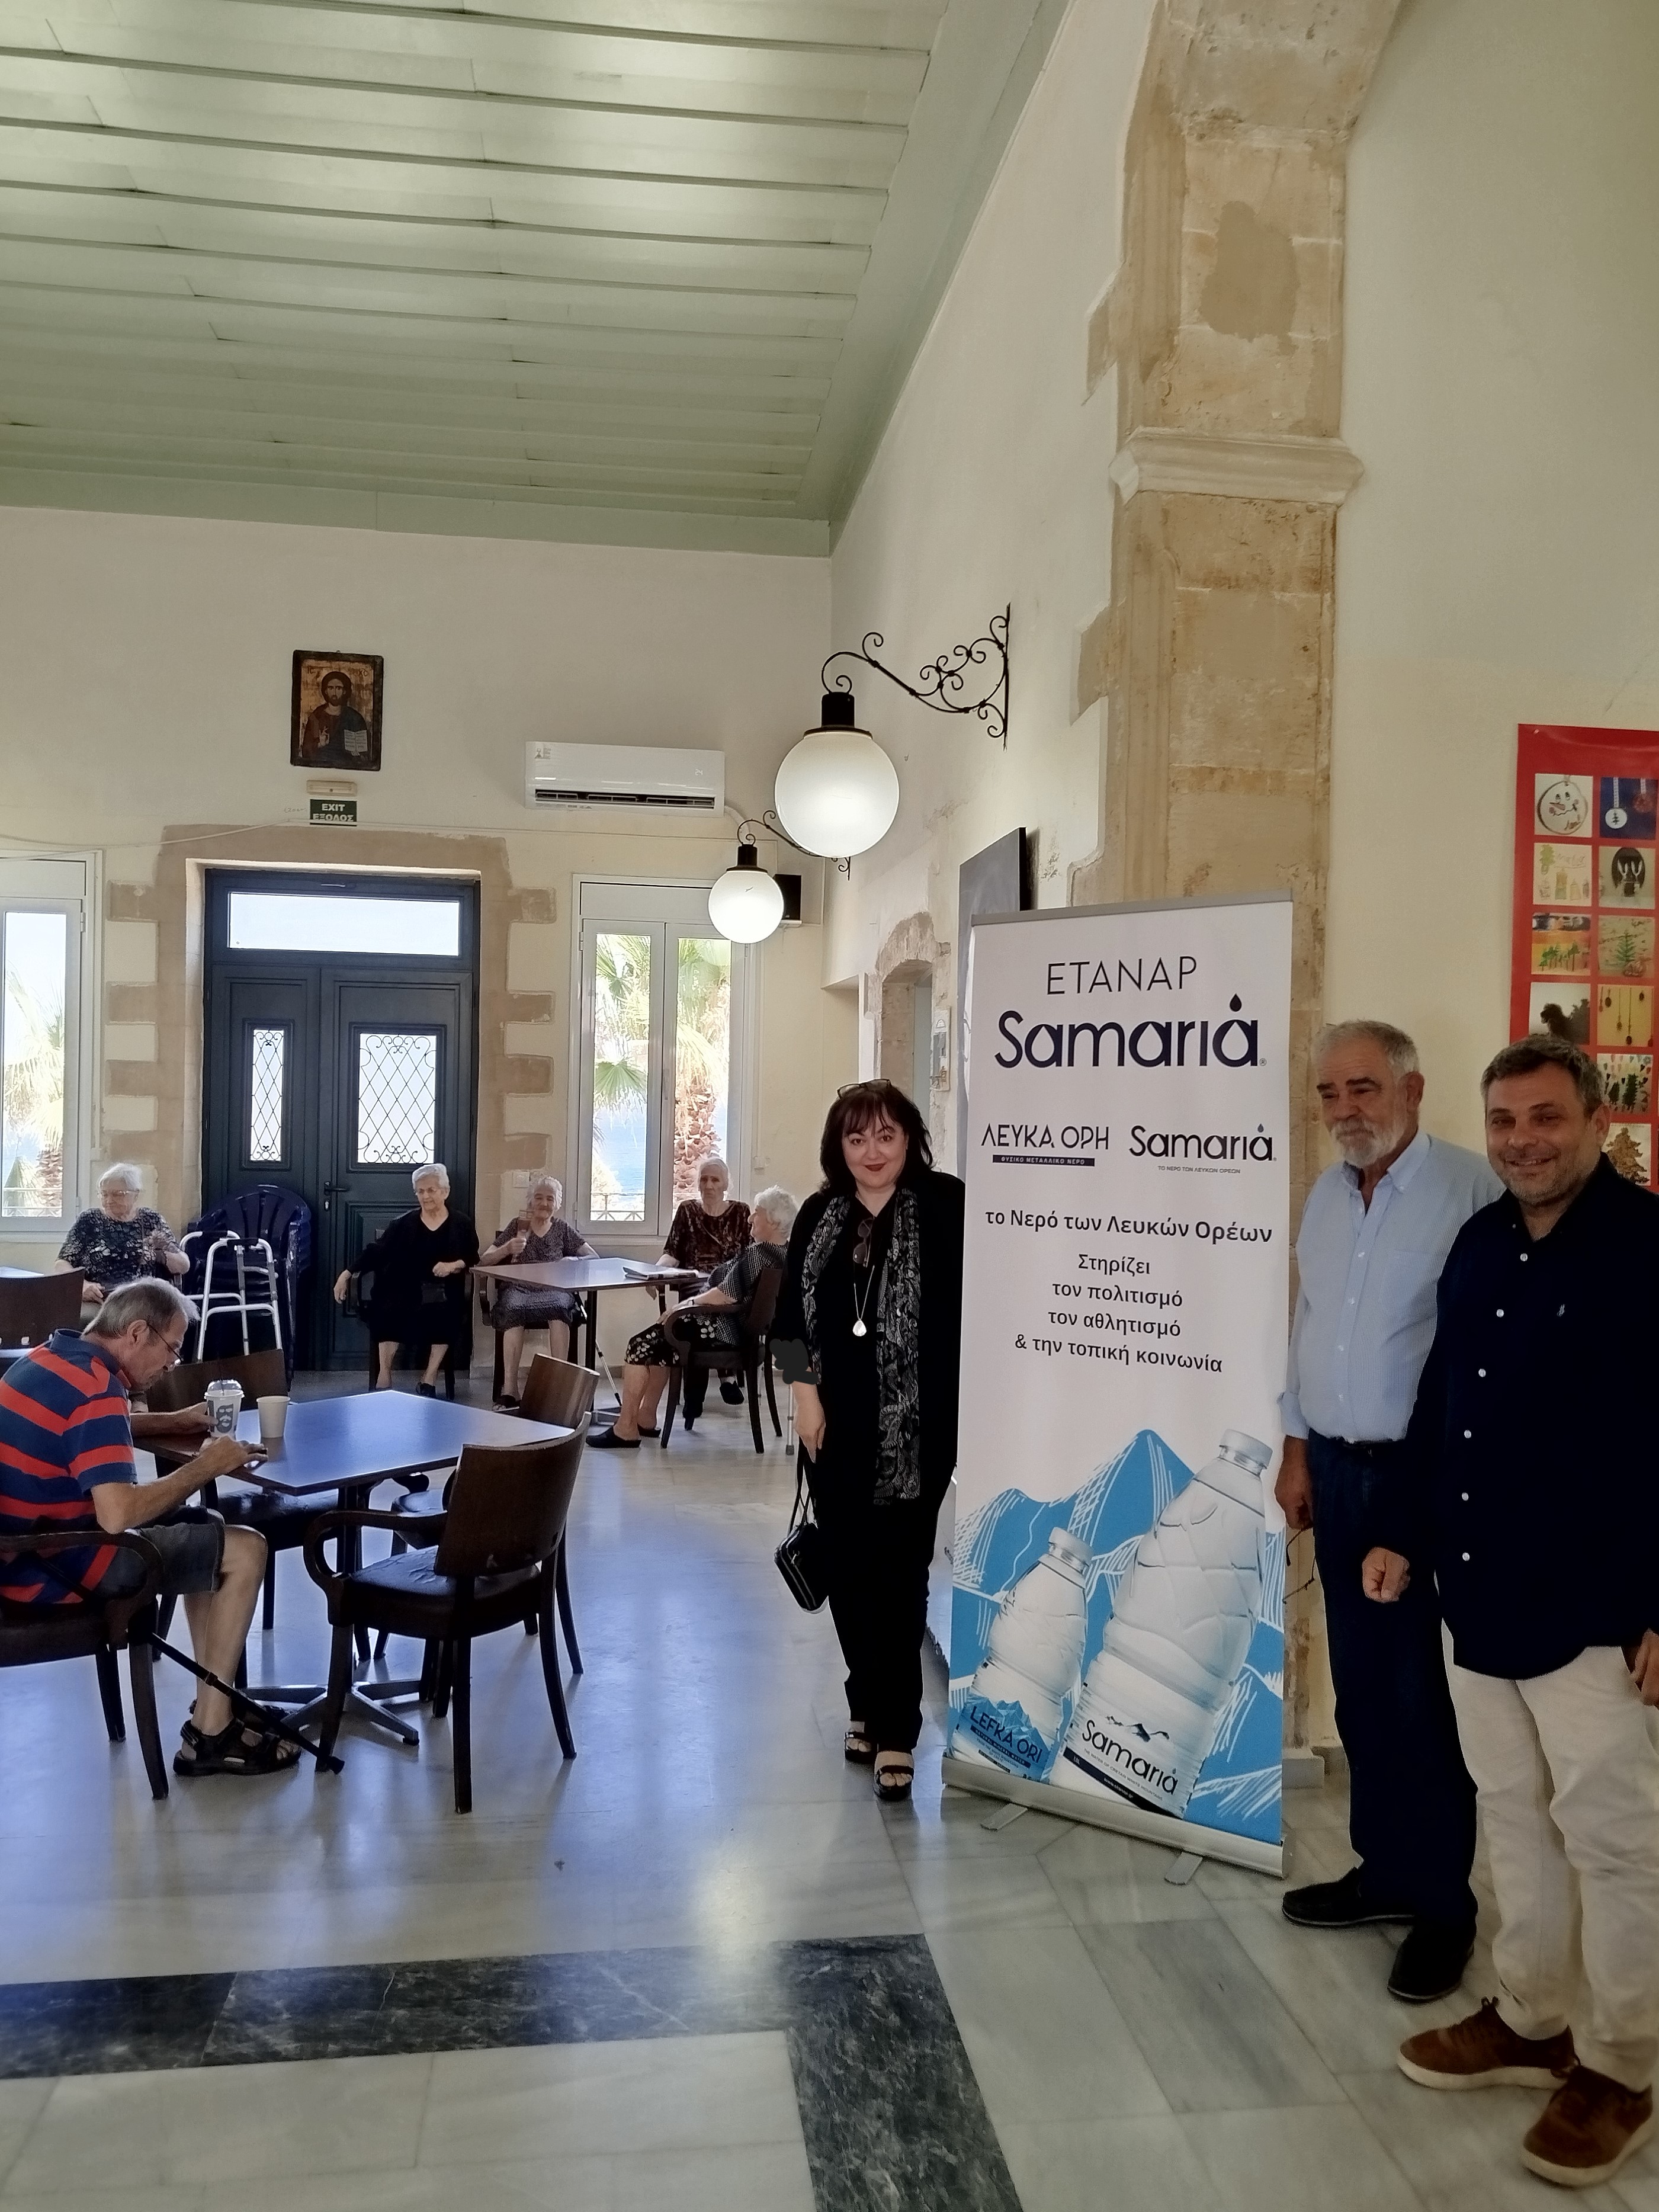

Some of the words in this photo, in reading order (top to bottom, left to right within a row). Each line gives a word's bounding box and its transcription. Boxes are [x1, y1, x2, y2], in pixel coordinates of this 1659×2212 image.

[322, 803, 345, 812] EXIT
[1047, 956, 1197, 995] ΕΤΑΝΑΡ
[981, 1123, 1055, 1148] ΛΕΥΚΑ
[1061, 1126, 1109, 1150] ΟΡΗ
[985, 1211, 1005, 1224] το
[1010, 1210, 1058, 1232] Νερό
[1063, 1216, 1102, 1231] των
[1106, 1216, 1189, 1237] Λευκών
[1195, 1221, 1272, 1245] Ορέων
[1078, 1254, 1150, 1277] Στηρίζει
[1052, 1283, 1082, 1297] τον
[1087, 1284, 1183, 1309] πολιτισμό
[1048, 1312, 1077, 1326] τον
[1083, 1313, 1181, 1339] αθλητισμό
[1015, 1334, 1027, 1349] &
[1032, 1339, 1062, 1356] την
[1067, 1342, 1129, 1365] τοπική
[1136, 1349, 1222, 1373] κοινωνία
[970, 1706, 1013, 1748] LEFKA
[1017, 1739, 1042, 1763] ORI
